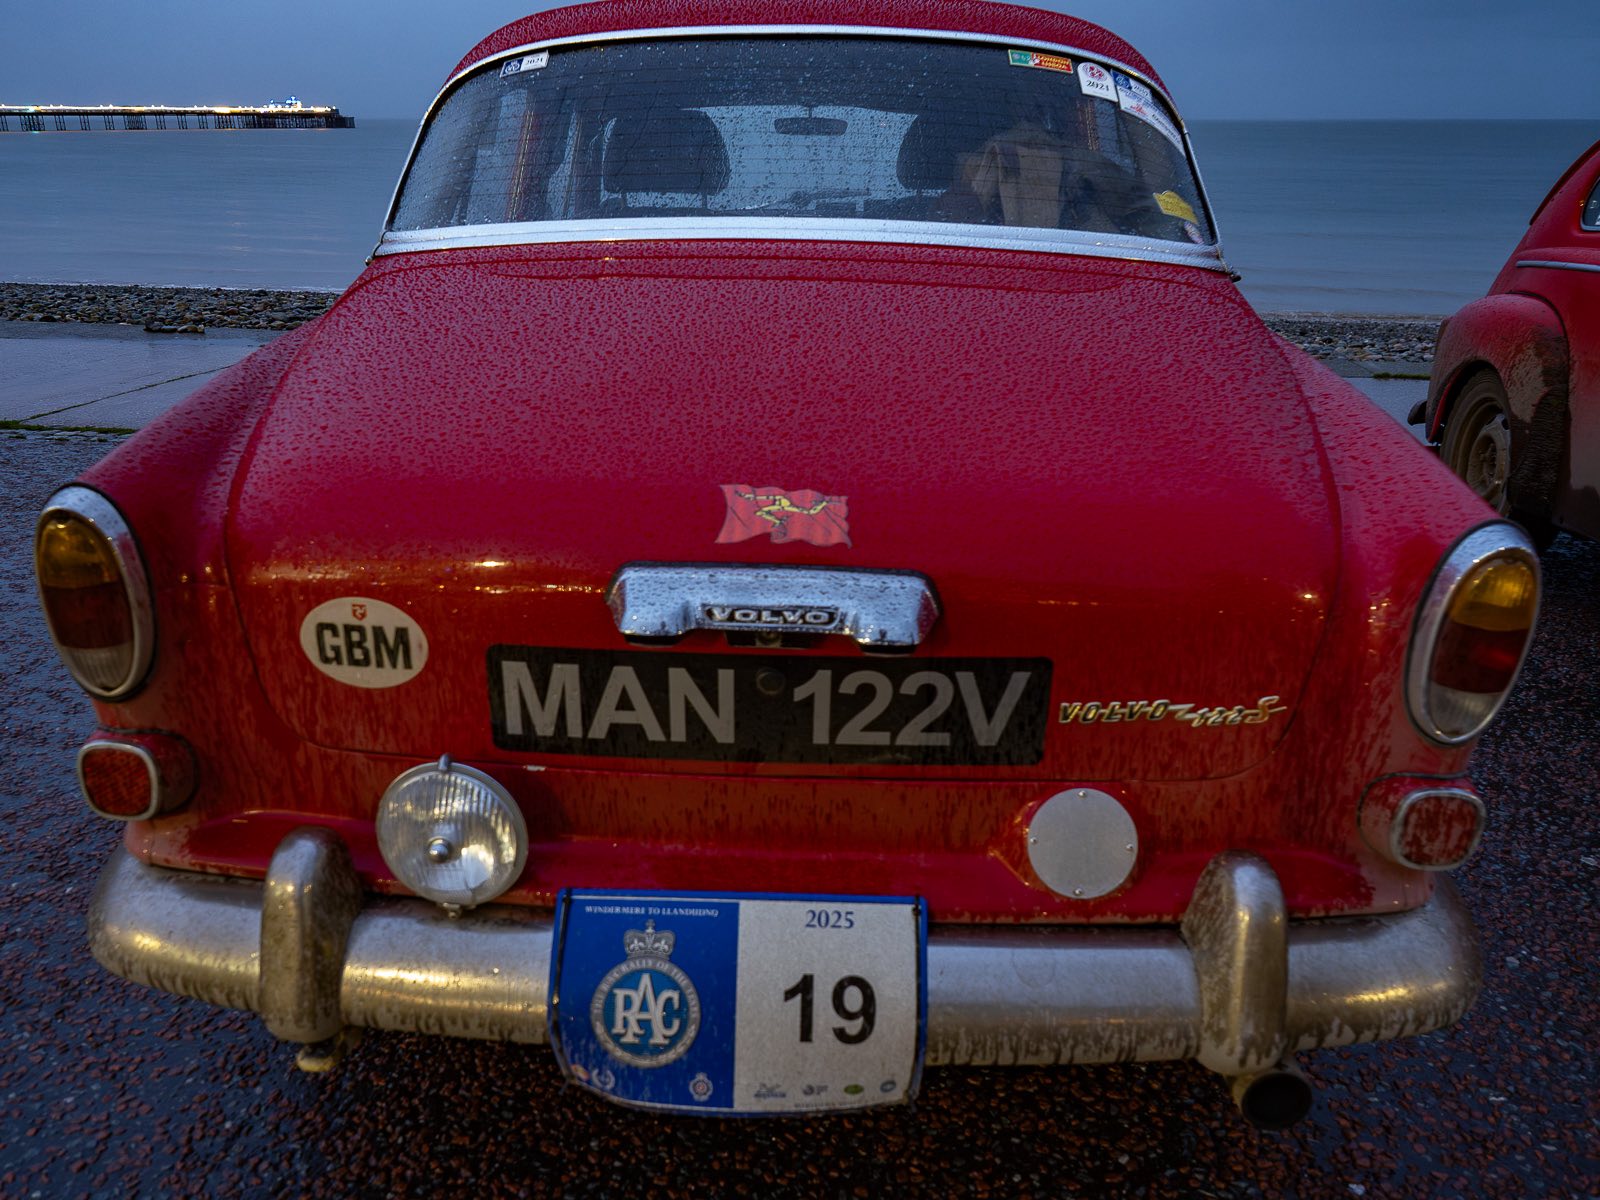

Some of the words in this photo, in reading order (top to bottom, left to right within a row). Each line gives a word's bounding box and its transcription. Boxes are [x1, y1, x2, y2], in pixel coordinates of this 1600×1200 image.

[709, 607, 831, 625] VOLVO
[315, 622, 414, 671] GBM
[501, 660, 735, 745] MAN
[792, 668, 1032, 747] 122V
[1059, 699, 1170, 723] VOLVO
[805, 909, 855, 929] 2025
[611, 973, 680, 1044] RAC
[783, 972, 877, 1045] 19
